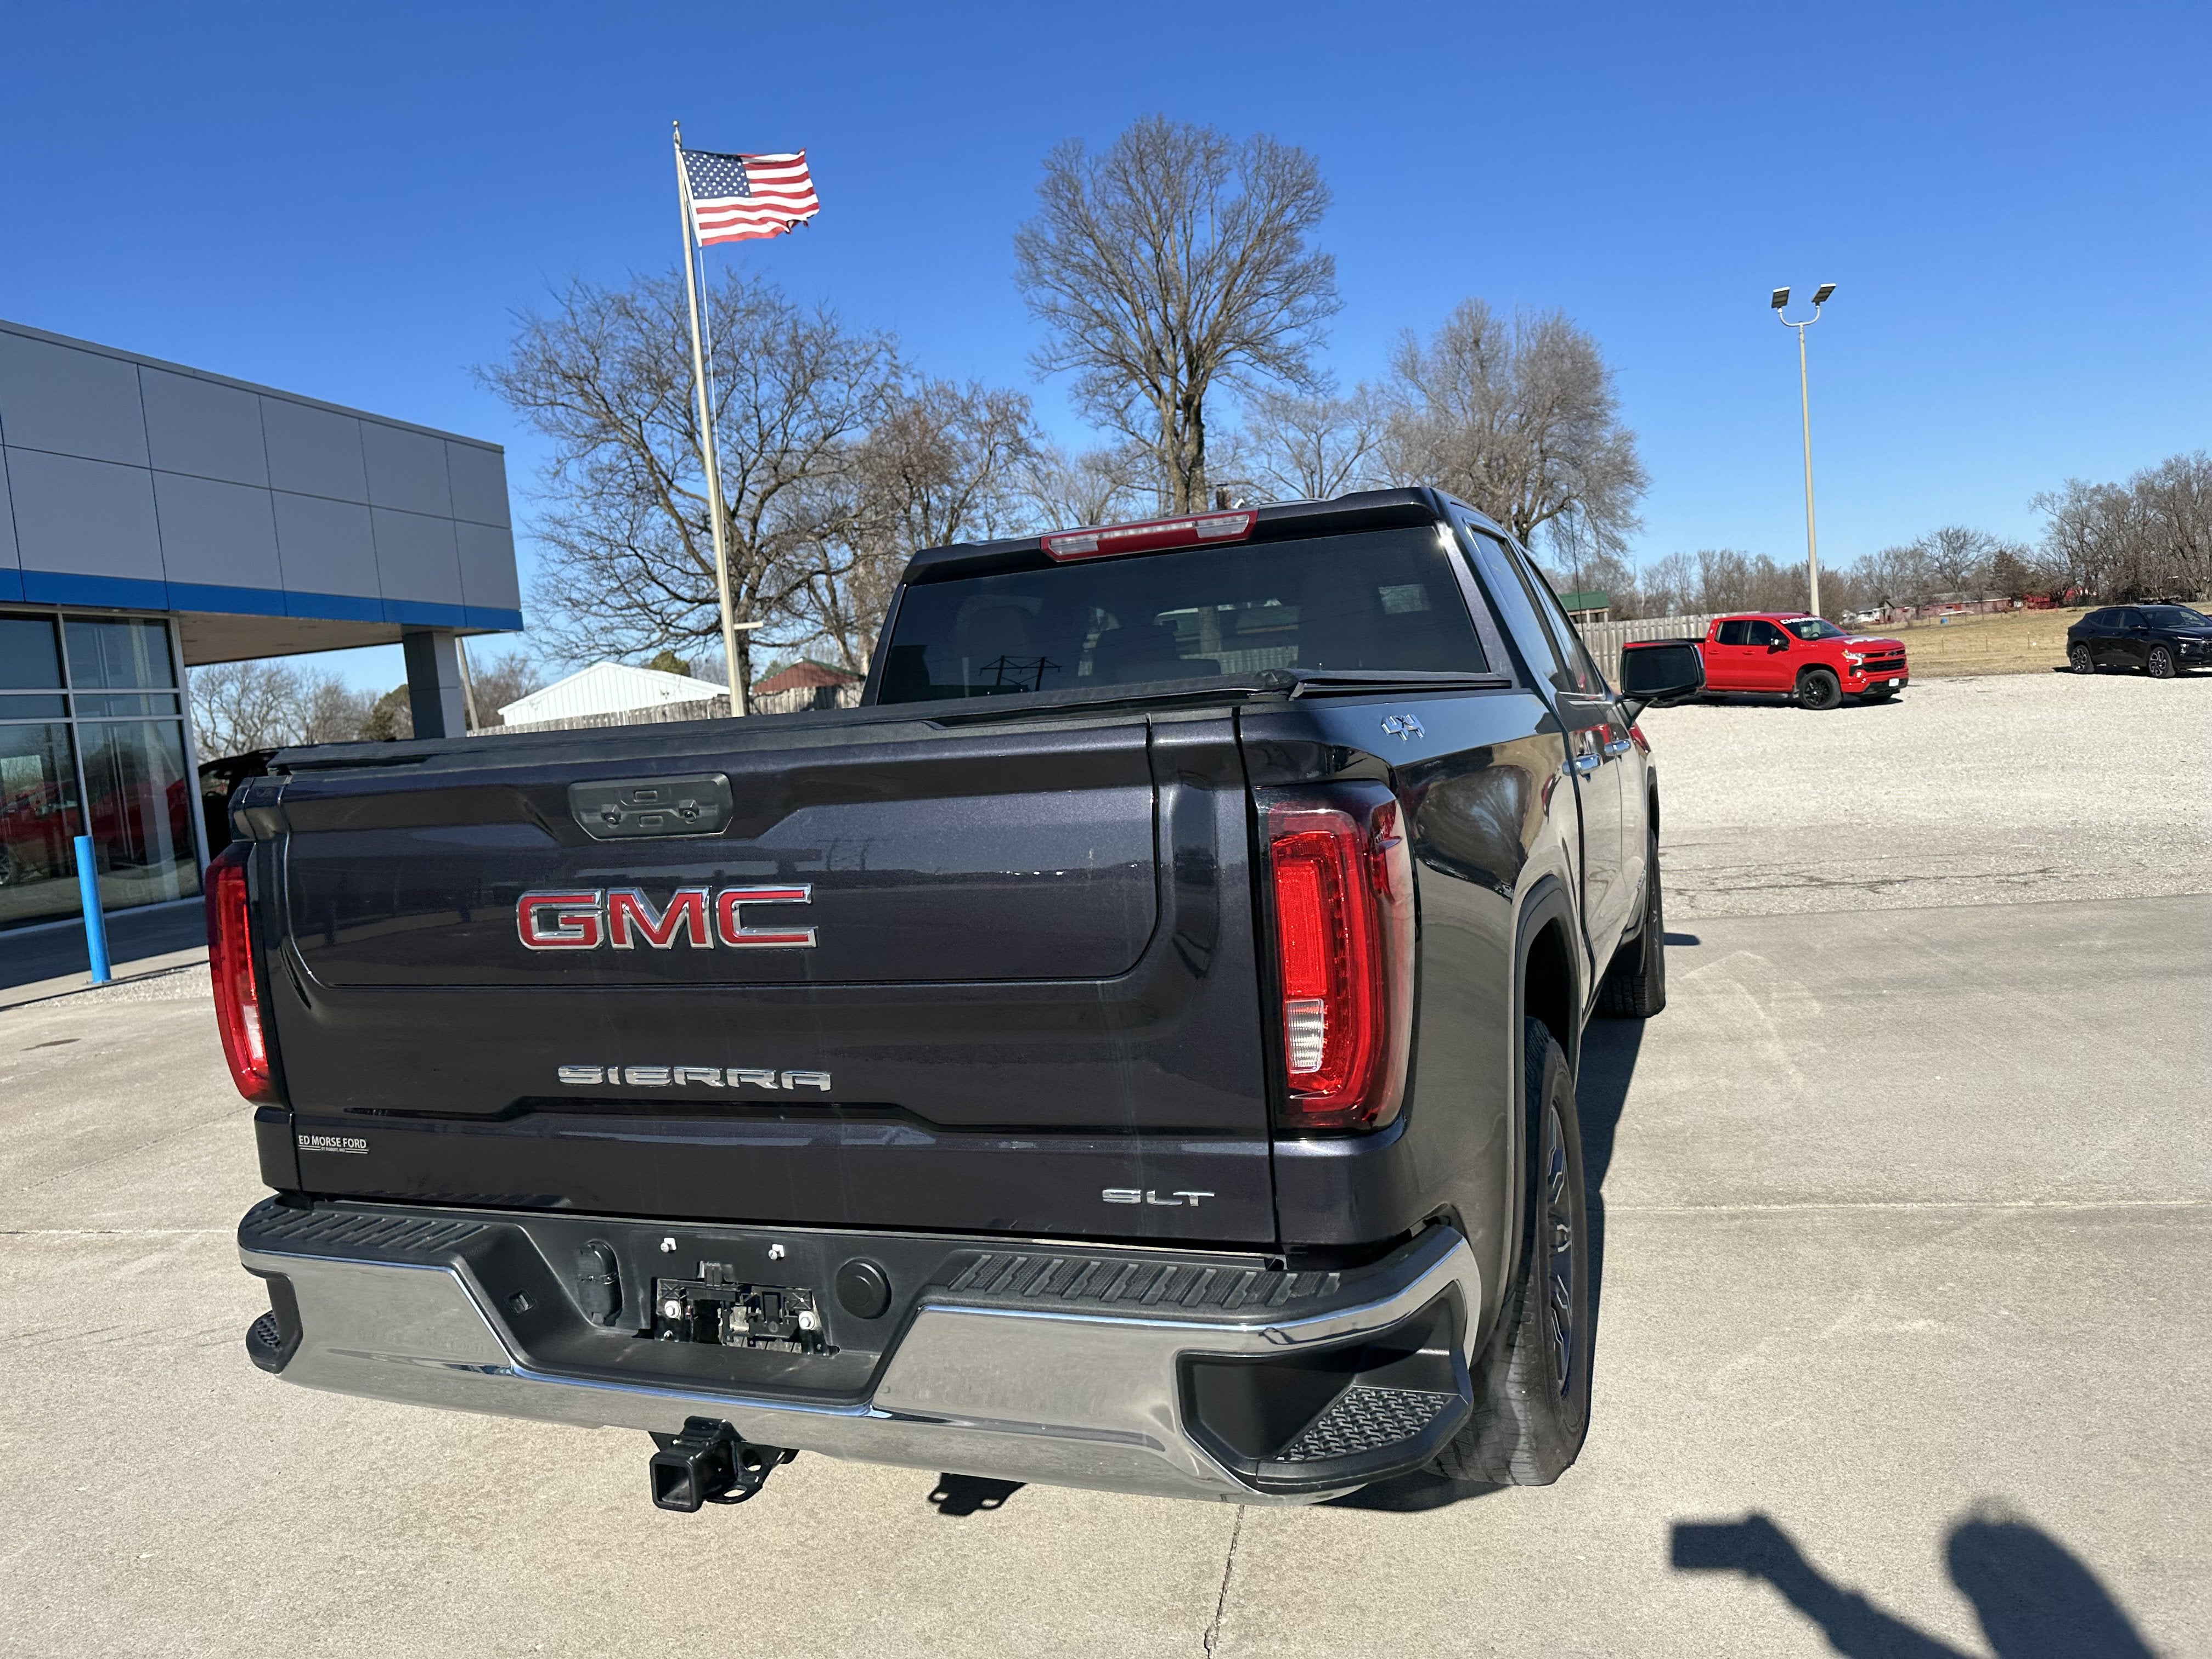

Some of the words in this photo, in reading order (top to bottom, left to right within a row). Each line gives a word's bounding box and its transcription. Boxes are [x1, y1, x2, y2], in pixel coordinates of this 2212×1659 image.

[516, 884, 817, 950] GMC
[558, 1066, 832, 1092] SIERRA
[298, 1135, 310, 1145] ED
[312, 1135, 341, 1147] MORSE
[343, 1138, 366, 1148] FORD
[1102, 1189, 1215, 1207] SLT
